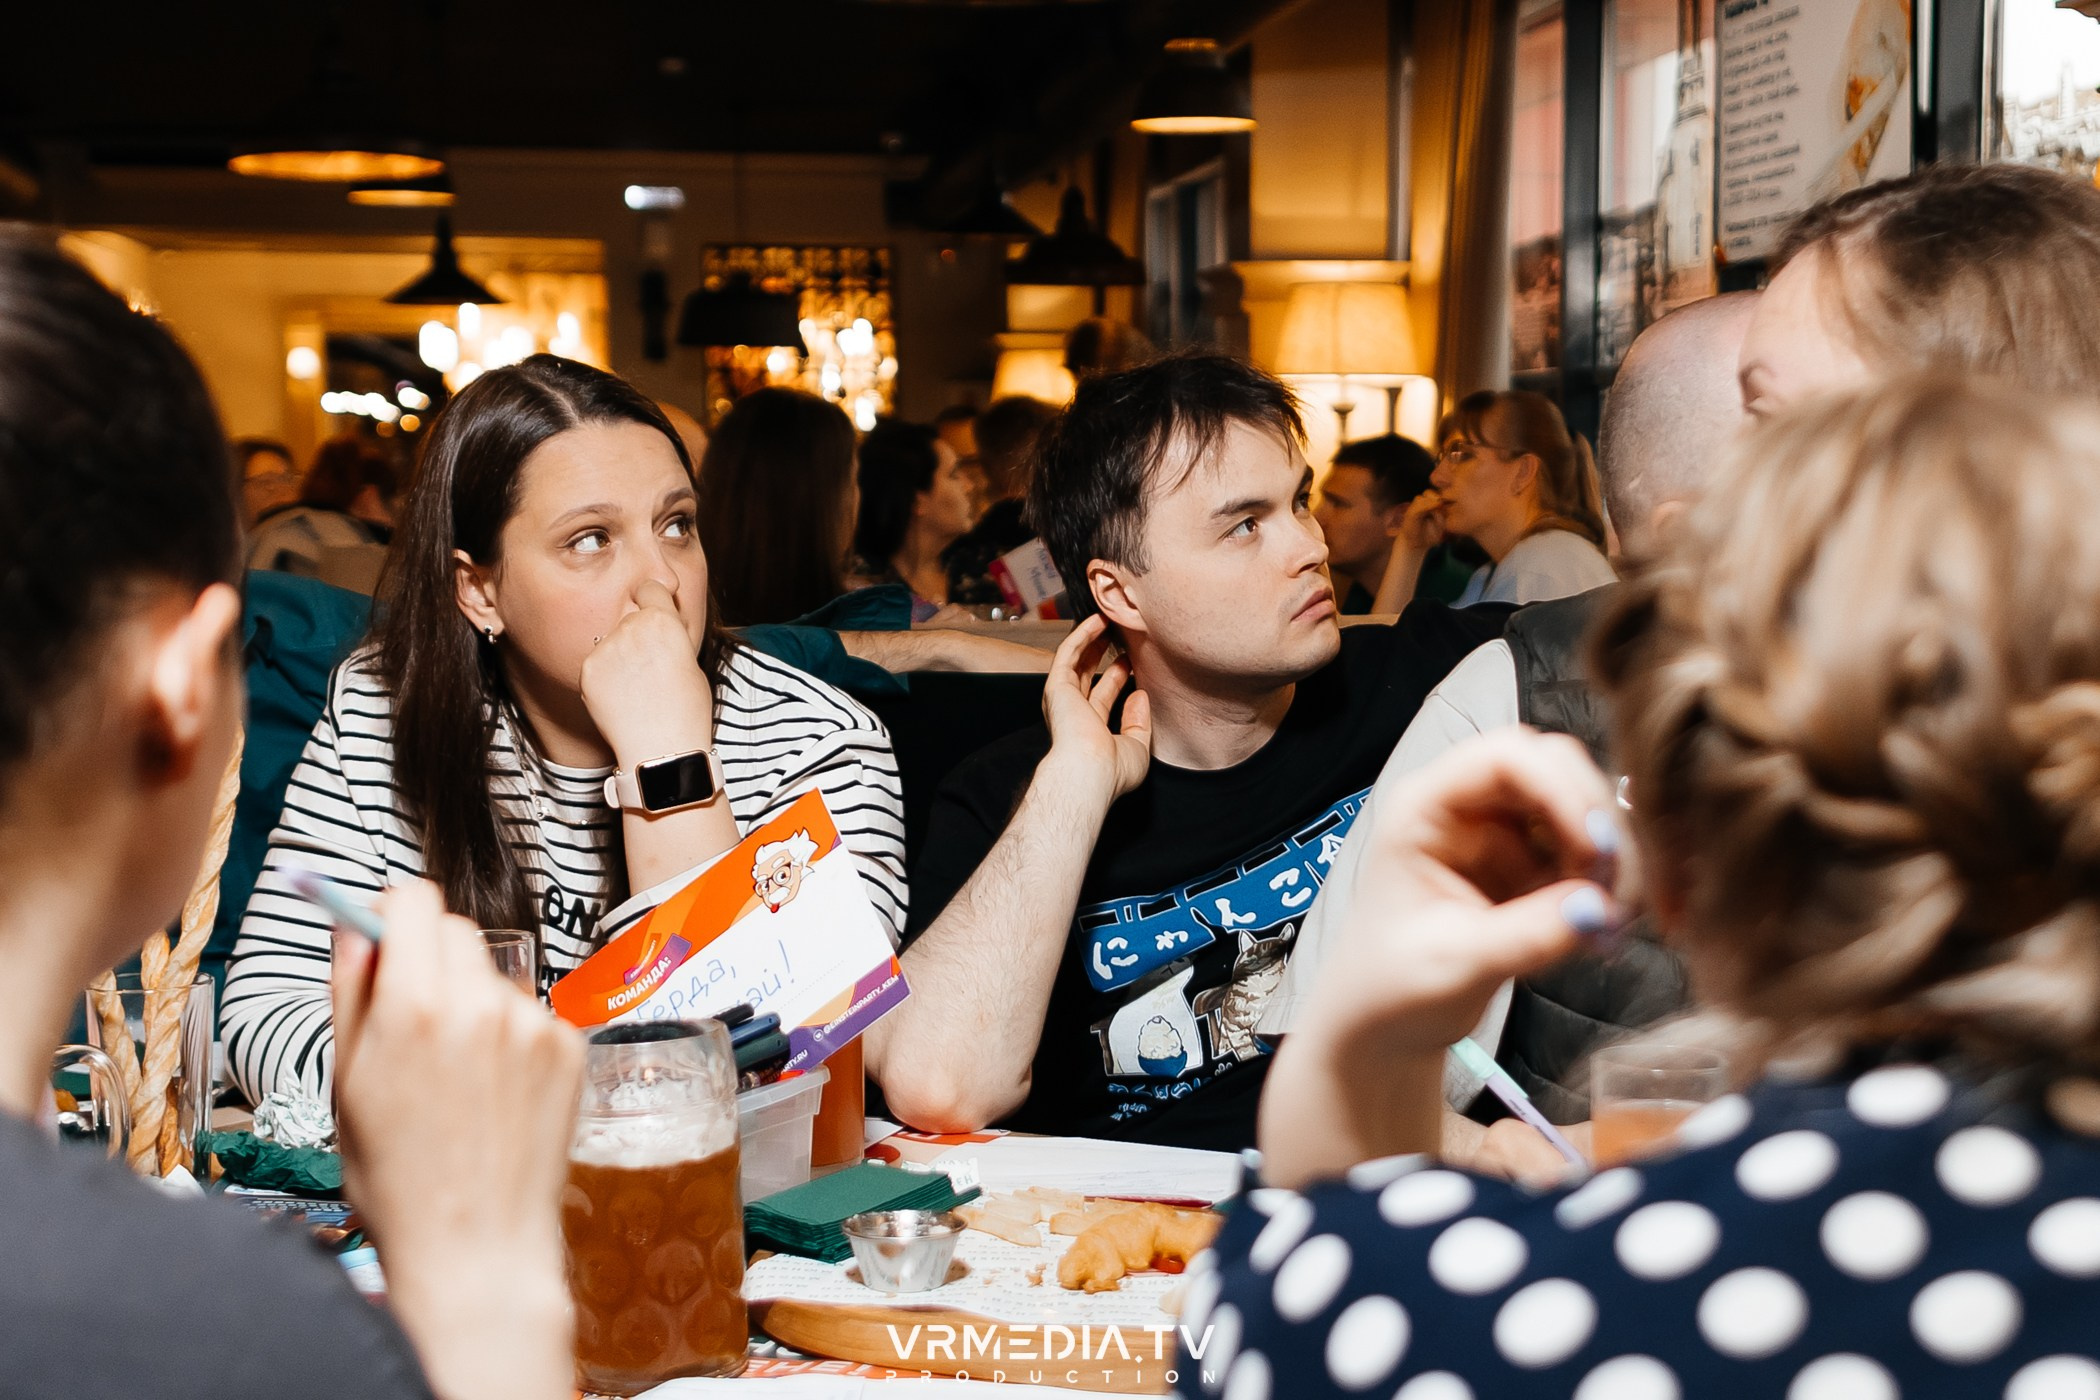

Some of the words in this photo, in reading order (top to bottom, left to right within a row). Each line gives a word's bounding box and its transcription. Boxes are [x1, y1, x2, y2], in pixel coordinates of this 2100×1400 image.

[607, 956, 672, 1011] КОМАНДА:
[636, 958, 736, 1021] Герда,
[823, 974, 900, 1034] @EINSTEINPARTY_KEM
